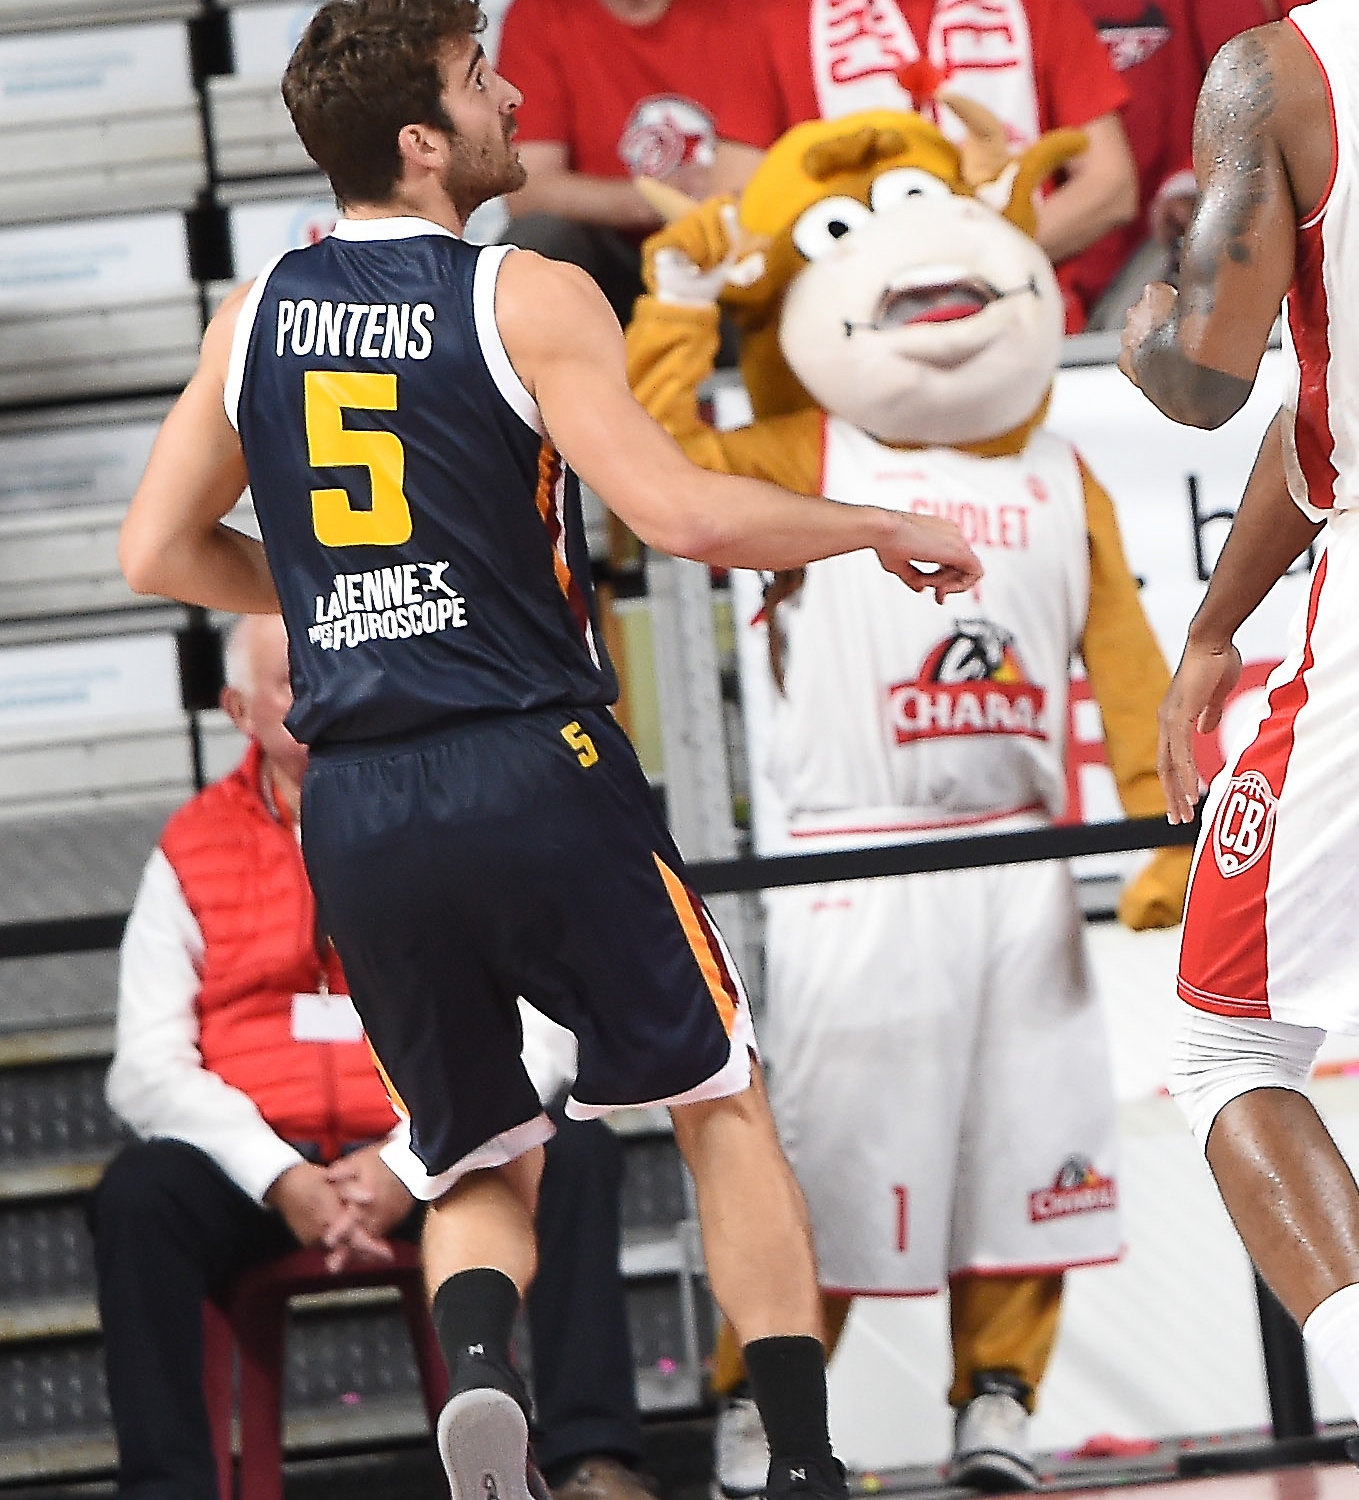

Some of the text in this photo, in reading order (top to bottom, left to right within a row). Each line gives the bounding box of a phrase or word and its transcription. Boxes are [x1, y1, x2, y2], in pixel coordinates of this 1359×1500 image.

[276, 299, 435, 360] PONTENS
[304, 371, 412, 548] 5
[561, 721, 598, 768] 5
[1220, 791, 1265, 856] CB
